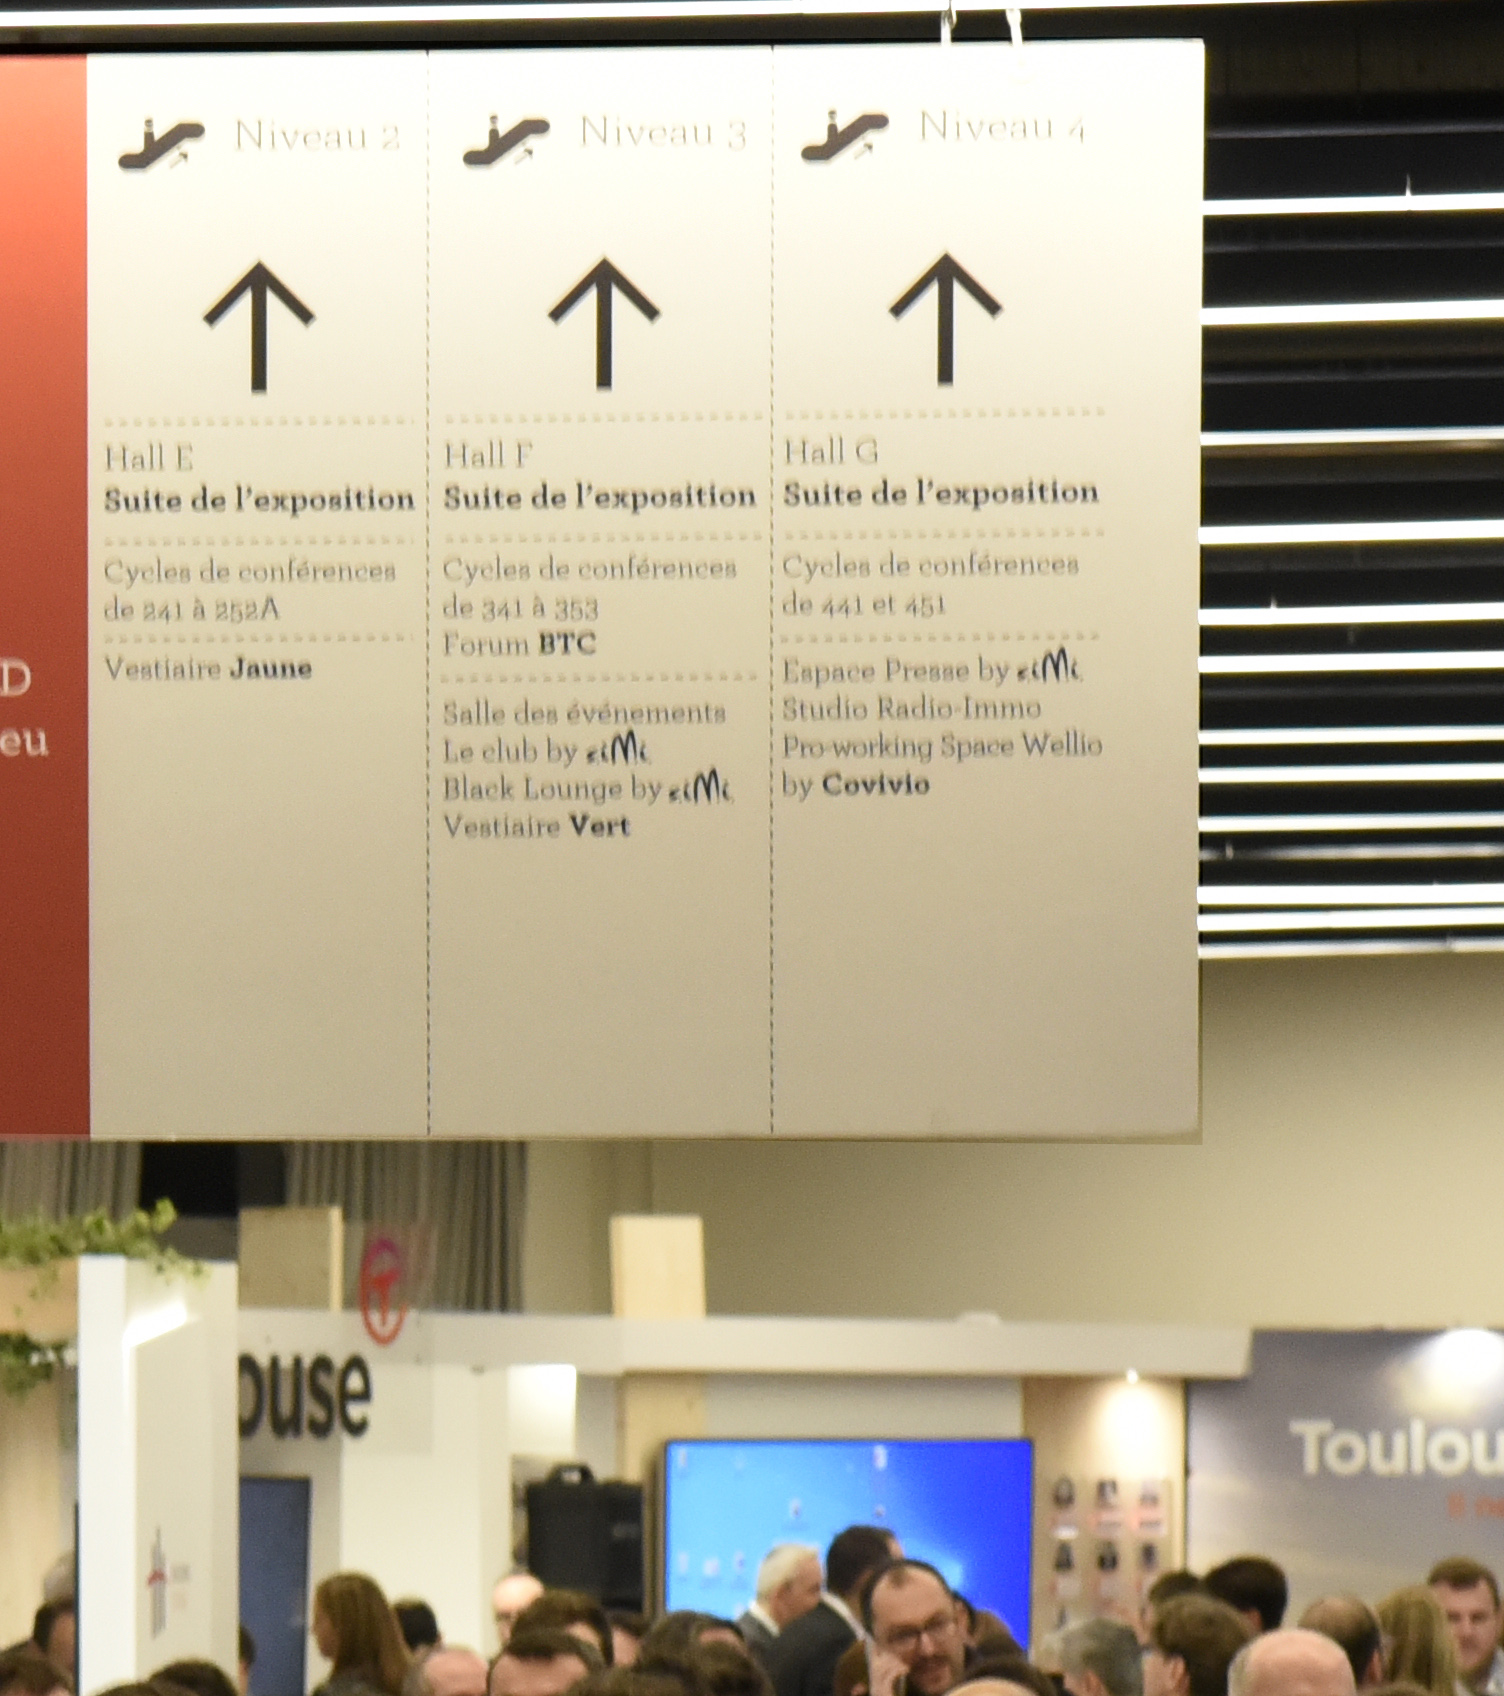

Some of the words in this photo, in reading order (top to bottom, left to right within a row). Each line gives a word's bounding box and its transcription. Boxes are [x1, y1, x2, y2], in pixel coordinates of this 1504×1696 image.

[235, 117, 366, 150] Niveau
[381, 126, 400, 150] 2
[580, 112, 713, 146] Niveau
[727, 121, 747, 150] 3
[919, 107, 1054, 141] Niveau
[1067, 118, 1087, 146] 4
[104, 441, 165, 472] Hall
[176, 442, 194, 472] E
[444, 438, 504, 470] Hall
[515, 439, 534, 469] F
[783, 434, 844, 466] Hall
[854, 436, 879, 465] G
[103, 484, 183, 514] Suite
[190, 482, 227, 514] de
[443, 481, 523, 512] Suite
[530, 479, 568, 511] de
[782, 477, 863, 508] Suite
[870, 475, 908, 508] de
[103, 556, 191, 590] Cycles
[199, 556, 231, 584] de
[238, 554, 396, 583] conférences
[442, 552, 531, 588] Cycles
[538, 552, 570, 581] de
[577, 552, 738, 580] conférences
[782, 550, 871, 585] Cycles
[879, 549, 911, 577] de
[918, 549, 1080, 577] conférences
[103, 593, 134, 622] de
[143, 598, 183, 624] 241
[192, 596, 206, 621] à
[215, 594, 280, 624] 252A
[442, 590, 474, 619] de
[481, 597, 522, 622] 341
[532, 594, 546, 619] à
[554, 597, 599, 622] 353
[781, 587, 814, 616] de
[821, 593, 863, 619] 441
[871, 592, 895, 616] et
[904, 593, 945, 618] 451
[443, 628, 530, 657] Forum
[538, 628, 597, 657] BTC
[104, 654, 222, 681] Vestiaire
[228, 653, 313, 681] Jaune
[783, 656, 876, 689] Espace
[885, 656, 970, 684] Presse
[977, 654, 1010, 688] by
[443, 698, 506, 726] Salle
[513, 697, 559, 725] des
[566, 700, 727, 726] événements
[782, 692, 868, 722] Studio
[877, 691, 1042, 721] Radio-Immo
[443, 738, 475, 764] Le
[481, 735, 538, 764] club
[546, 735, 579, 769] by
[940, 732, 1015, 764] Space
[1021, 729, 1104, 758] Wellio
[443, 773, 515, 802] Black
[523, 775, 624, 806] Lounge
[630, 773, 663, 806] by
[781, 770, 814, 803] by
[821, 770, 931, 797] Covivio
[442, 812, 561, 839] Vestiaire
[567, 811, 631, 839] Vert
[238, 1352, 372, 1440] ouse
